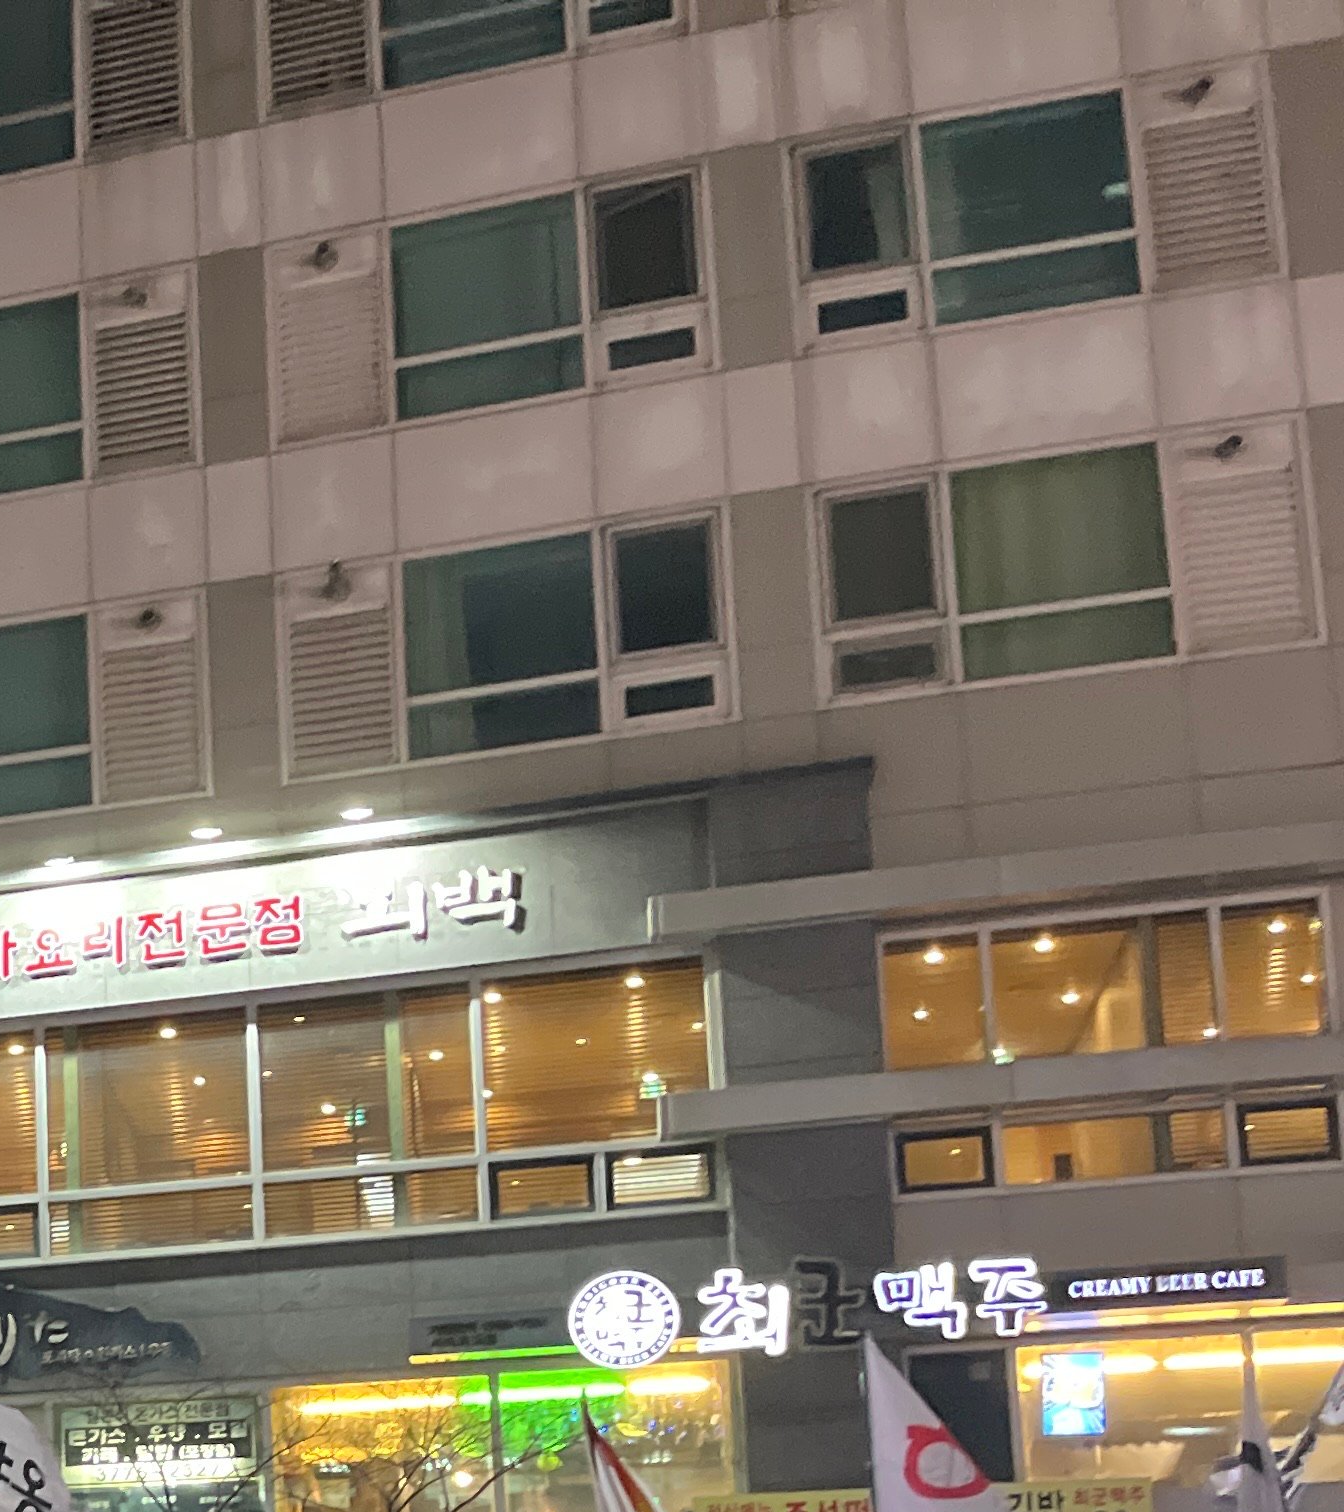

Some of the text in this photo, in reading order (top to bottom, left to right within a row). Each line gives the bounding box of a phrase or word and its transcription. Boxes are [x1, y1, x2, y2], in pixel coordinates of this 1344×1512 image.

[697, 1255, 1048, 1356] 최군맥주
[1068, 1276, 1151, 1299] CREAMY
[1211, 1268, 1266, 1289] CAFE
